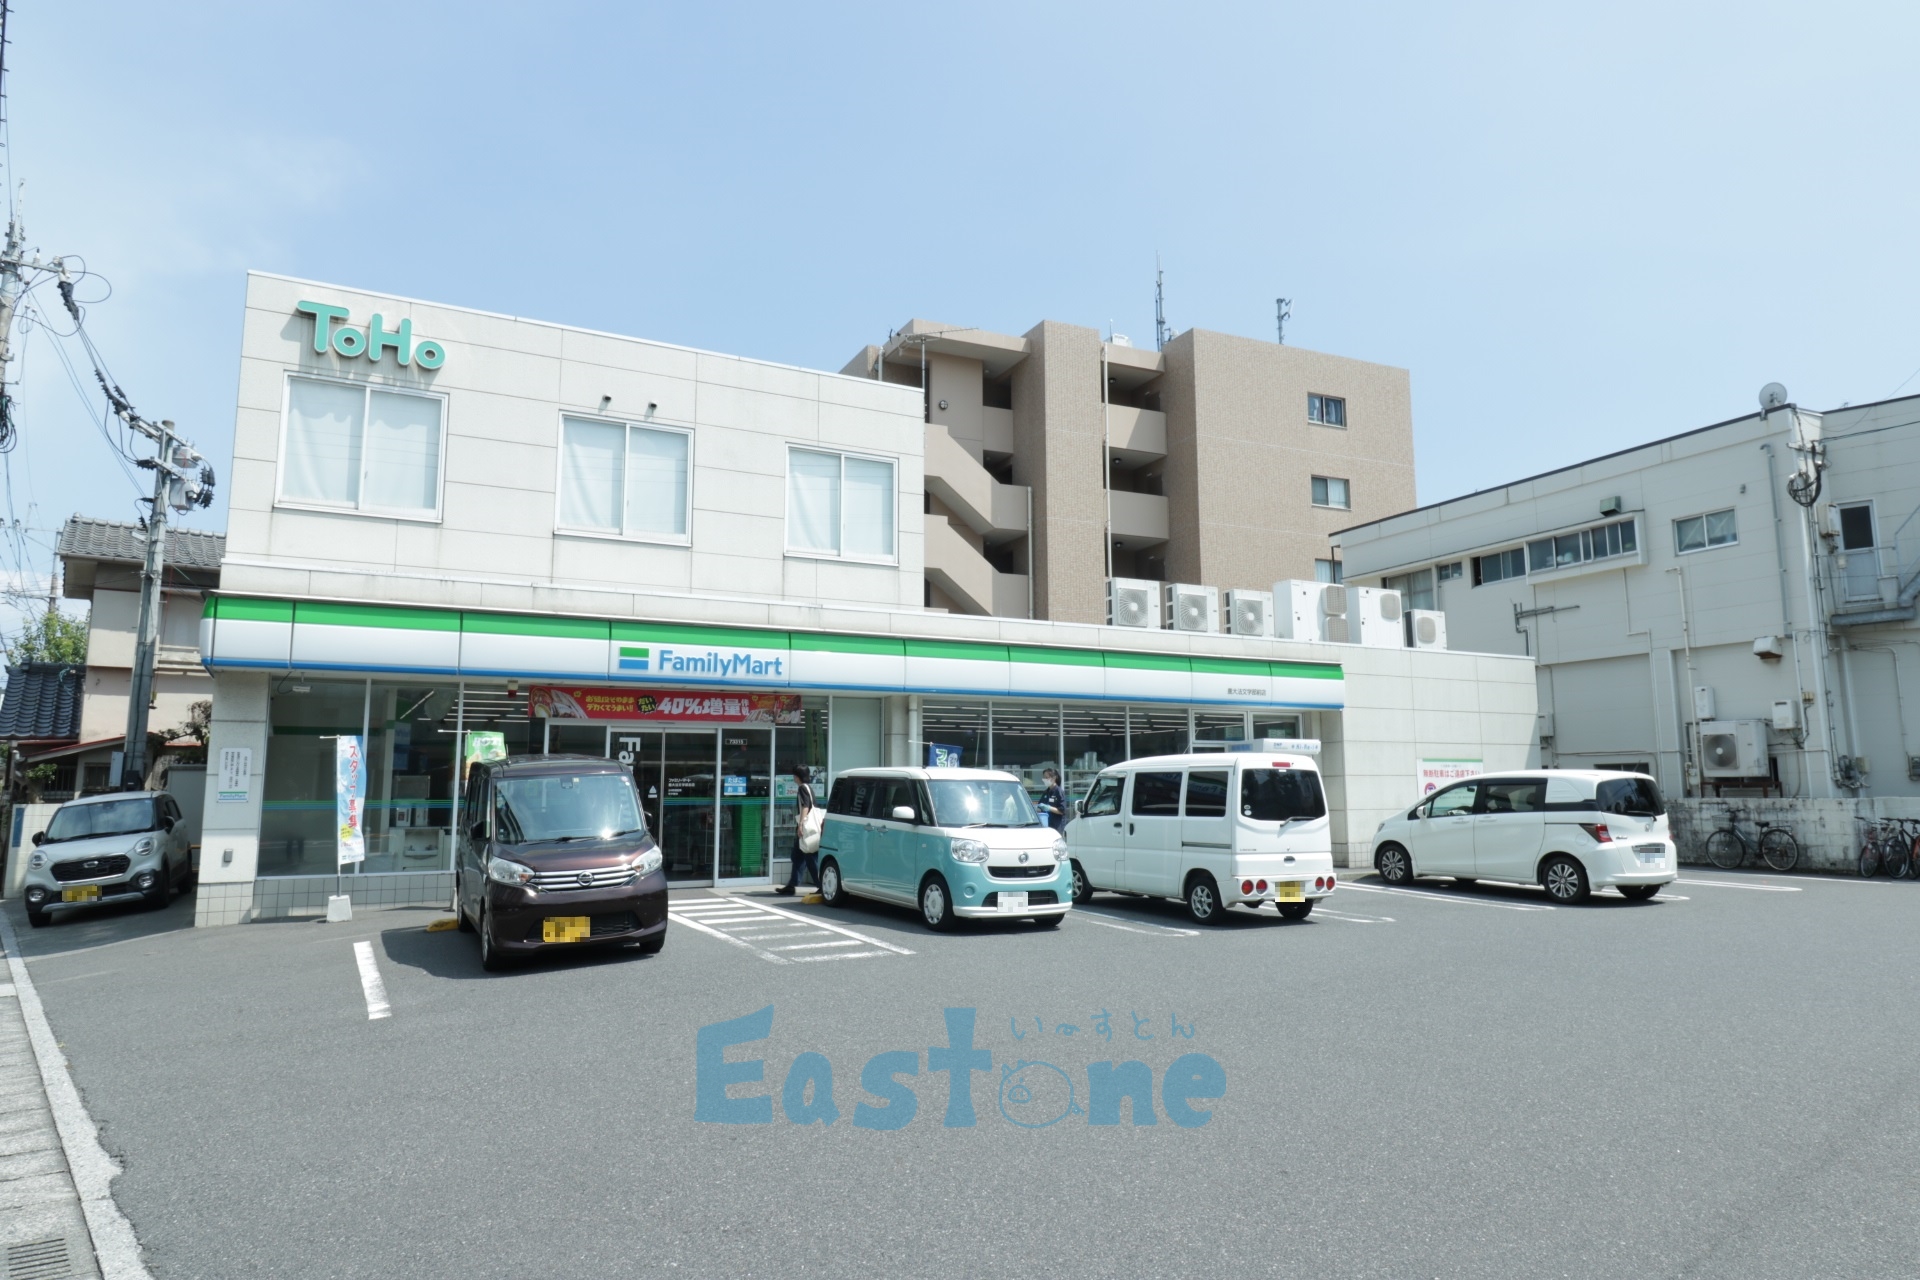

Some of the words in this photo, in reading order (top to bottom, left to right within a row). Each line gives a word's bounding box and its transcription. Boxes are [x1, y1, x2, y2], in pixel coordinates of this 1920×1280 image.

[297, 300, 446, 370] ToHo
[659, 649, 783, 676] FamilyMart
[657, 697, 741, 716] 40%増量
